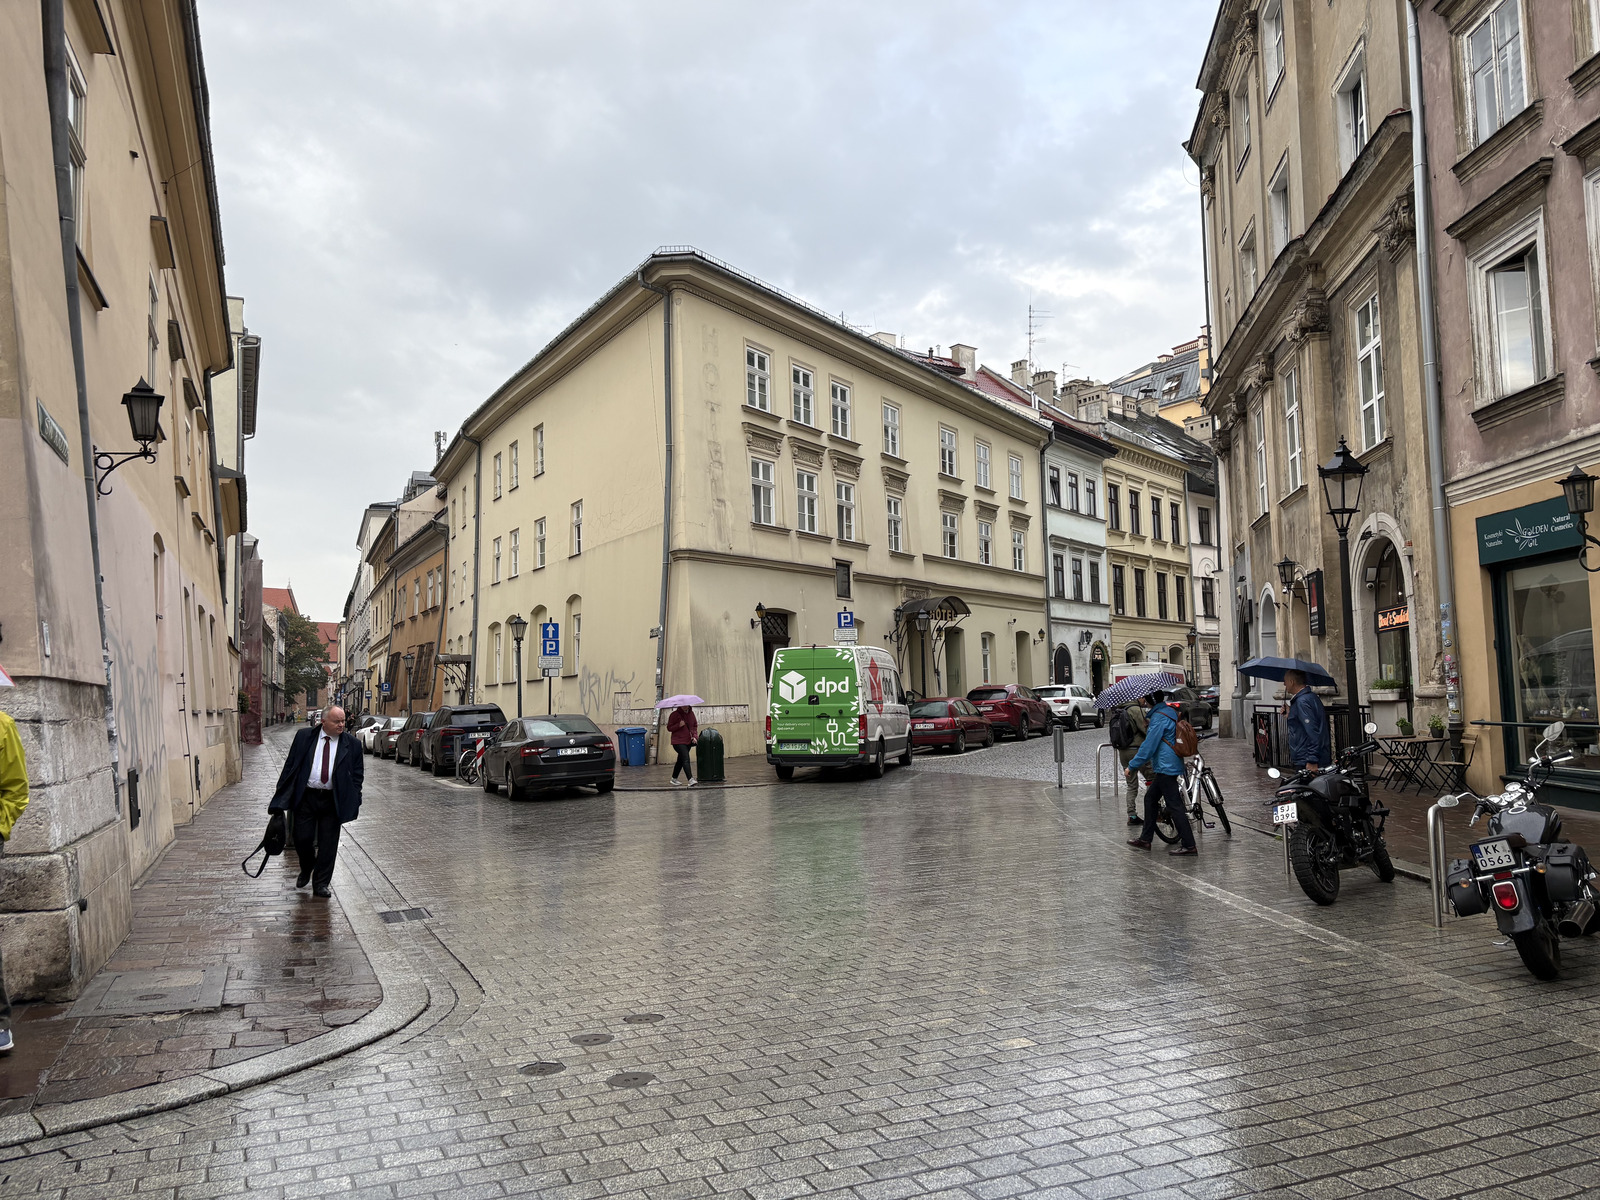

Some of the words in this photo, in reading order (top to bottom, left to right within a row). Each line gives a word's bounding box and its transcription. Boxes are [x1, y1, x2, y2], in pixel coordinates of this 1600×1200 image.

[1552, 513, 1571, 524] Natural
[1522, 524, 1549, 536] GOLDEN
[1550, 522, 1574, 533] Cosmetics
[1527, 538, 1539, 548] OIL
[841, 613, 851, 627] P
[929, 608, 956, 621] HOTEL
[546, 641, 556, 654] P
[814, 676, 849, 698] dpd
[1280, 805, 1290, 813] SJ
[1483, 844, 1500, 855] KK
[1480, 854, 1512, 868] 0563
